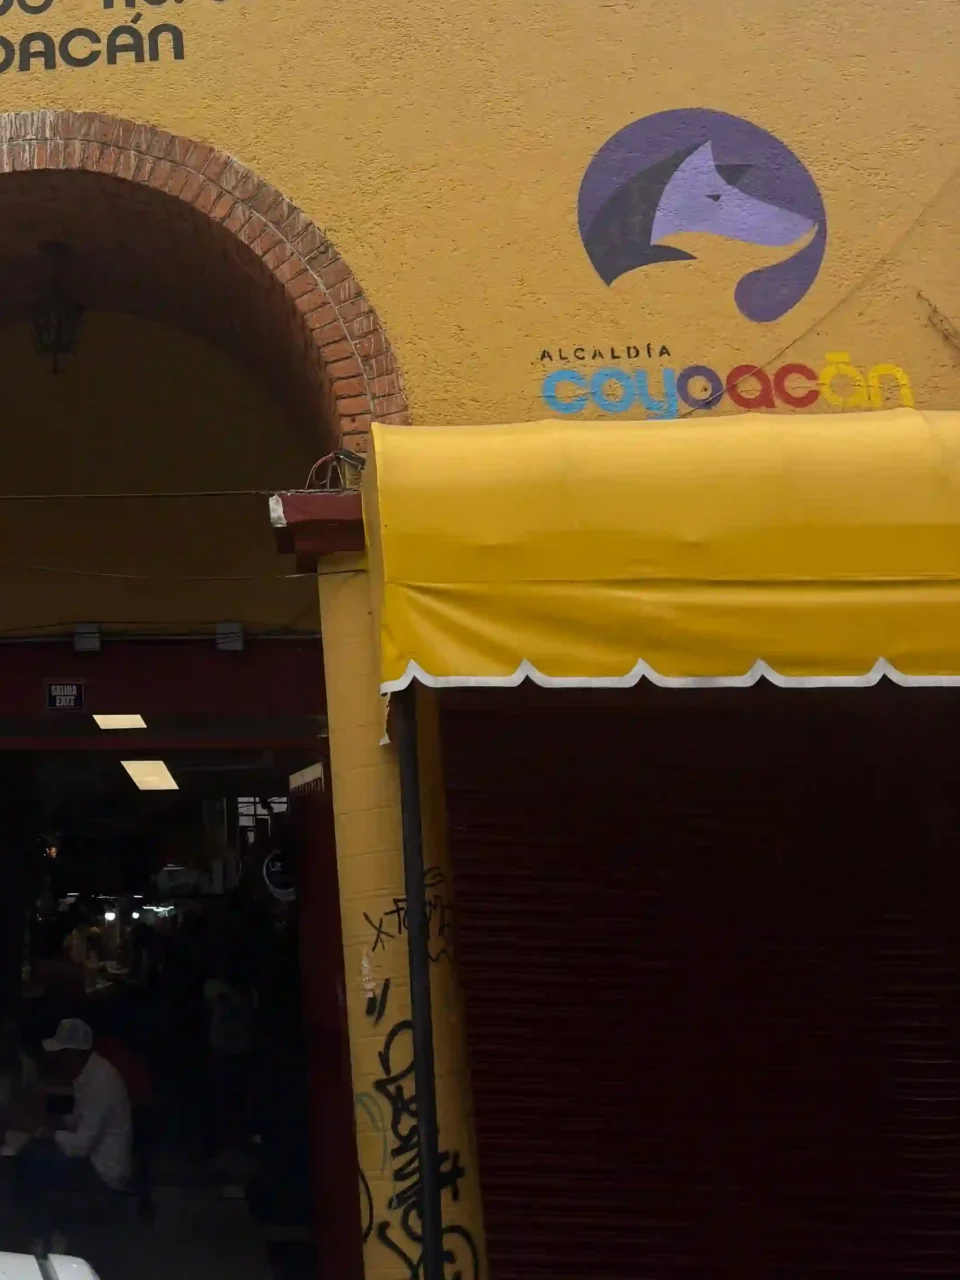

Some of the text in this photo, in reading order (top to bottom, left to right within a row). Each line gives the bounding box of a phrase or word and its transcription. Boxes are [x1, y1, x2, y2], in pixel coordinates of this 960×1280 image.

[540, 344, 672, 362] ALCALDÍA
[51, 685, 76, 695] SALIDA
[56, 696, 75, 706] EXIT
